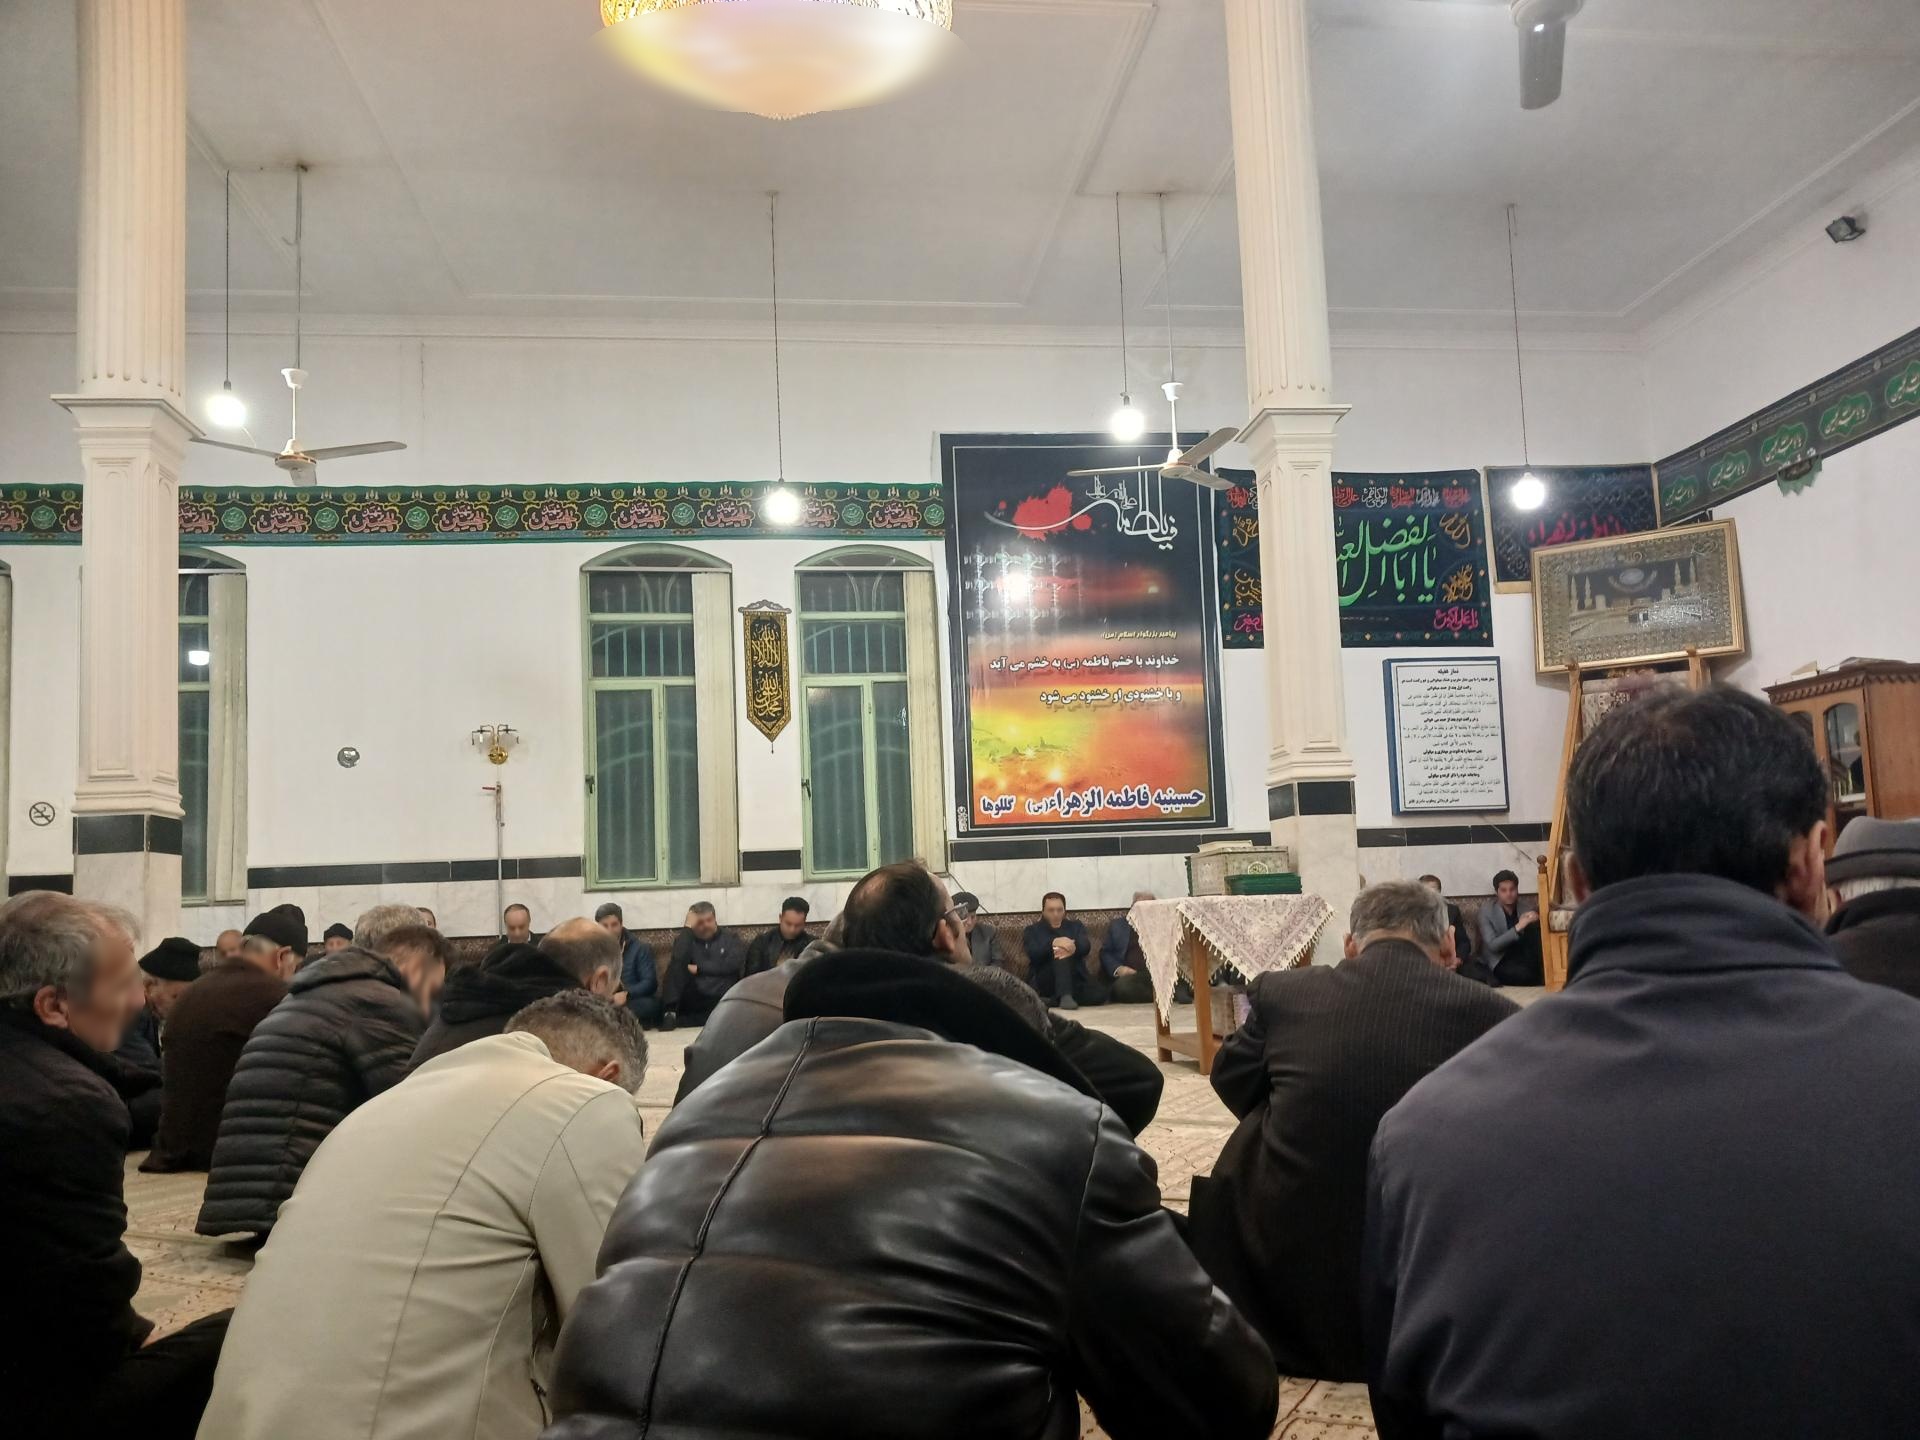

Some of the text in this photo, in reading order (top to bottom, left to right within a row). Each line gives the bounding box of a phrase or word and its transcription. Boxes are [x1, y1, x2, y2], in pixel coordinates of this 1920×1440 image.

[1417, 545, 1437, 602] یا
[1117, 630, 1136, 641] اسلام
[990, 656, 1007, 671] آید
[1009, 661, 1025, 672] می
[1028, 656, 1049, 671] خشم
[1052, 658, 1061, 670] به
[1082, 655, 1110, 668] فاطمه
[1112, 656, 1133, 669] خشم
[1135, 655, 1143, 668] با
[1146, 654, 1180, 668] خداوند
[1040, 686, 1181, 705] و با خشنودی او خشنود می شود
[1049, 787, 1103, 816] الزهراء
[1106, 786, 1150, 808] فاطمه
[1154, 788, 1204, 812] حسینیه
